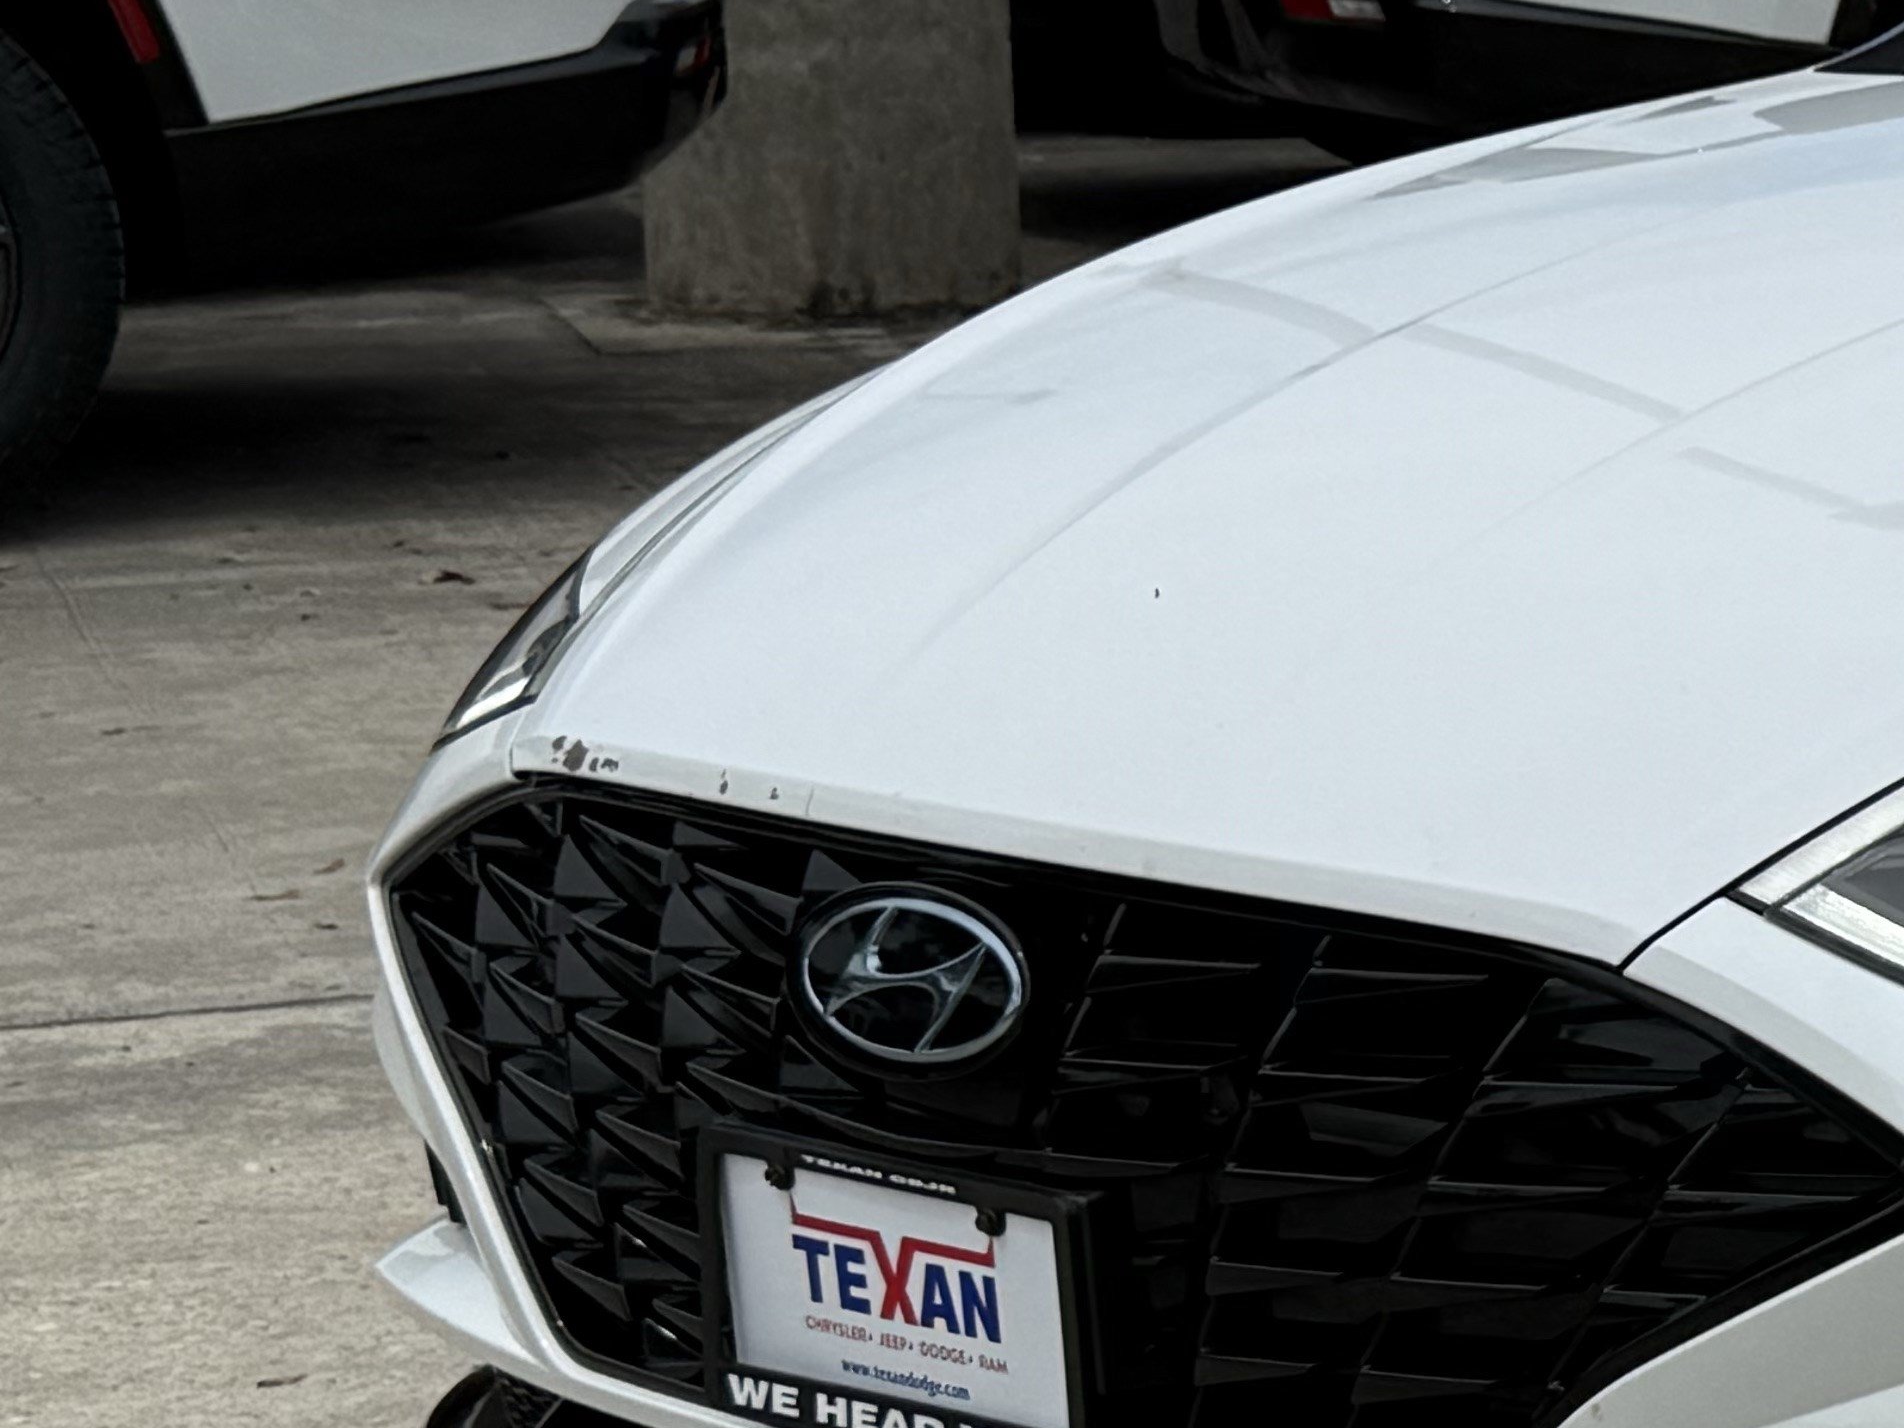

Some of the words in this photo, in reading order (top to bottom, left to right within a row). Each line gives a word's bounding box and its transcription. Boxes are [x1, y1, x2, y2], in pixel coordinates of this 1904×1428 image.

[791, 1212, 1001, 1344] TEXAN
[804, 1314, 868, 1343] CHRYSLER
[879, 1332, 908, 1352] JEEP
[918, 1341, 968, 1367] DODGE
[978, 1354, 1009, 1375] RAM
[728, 1373, 800, 1419] WE
